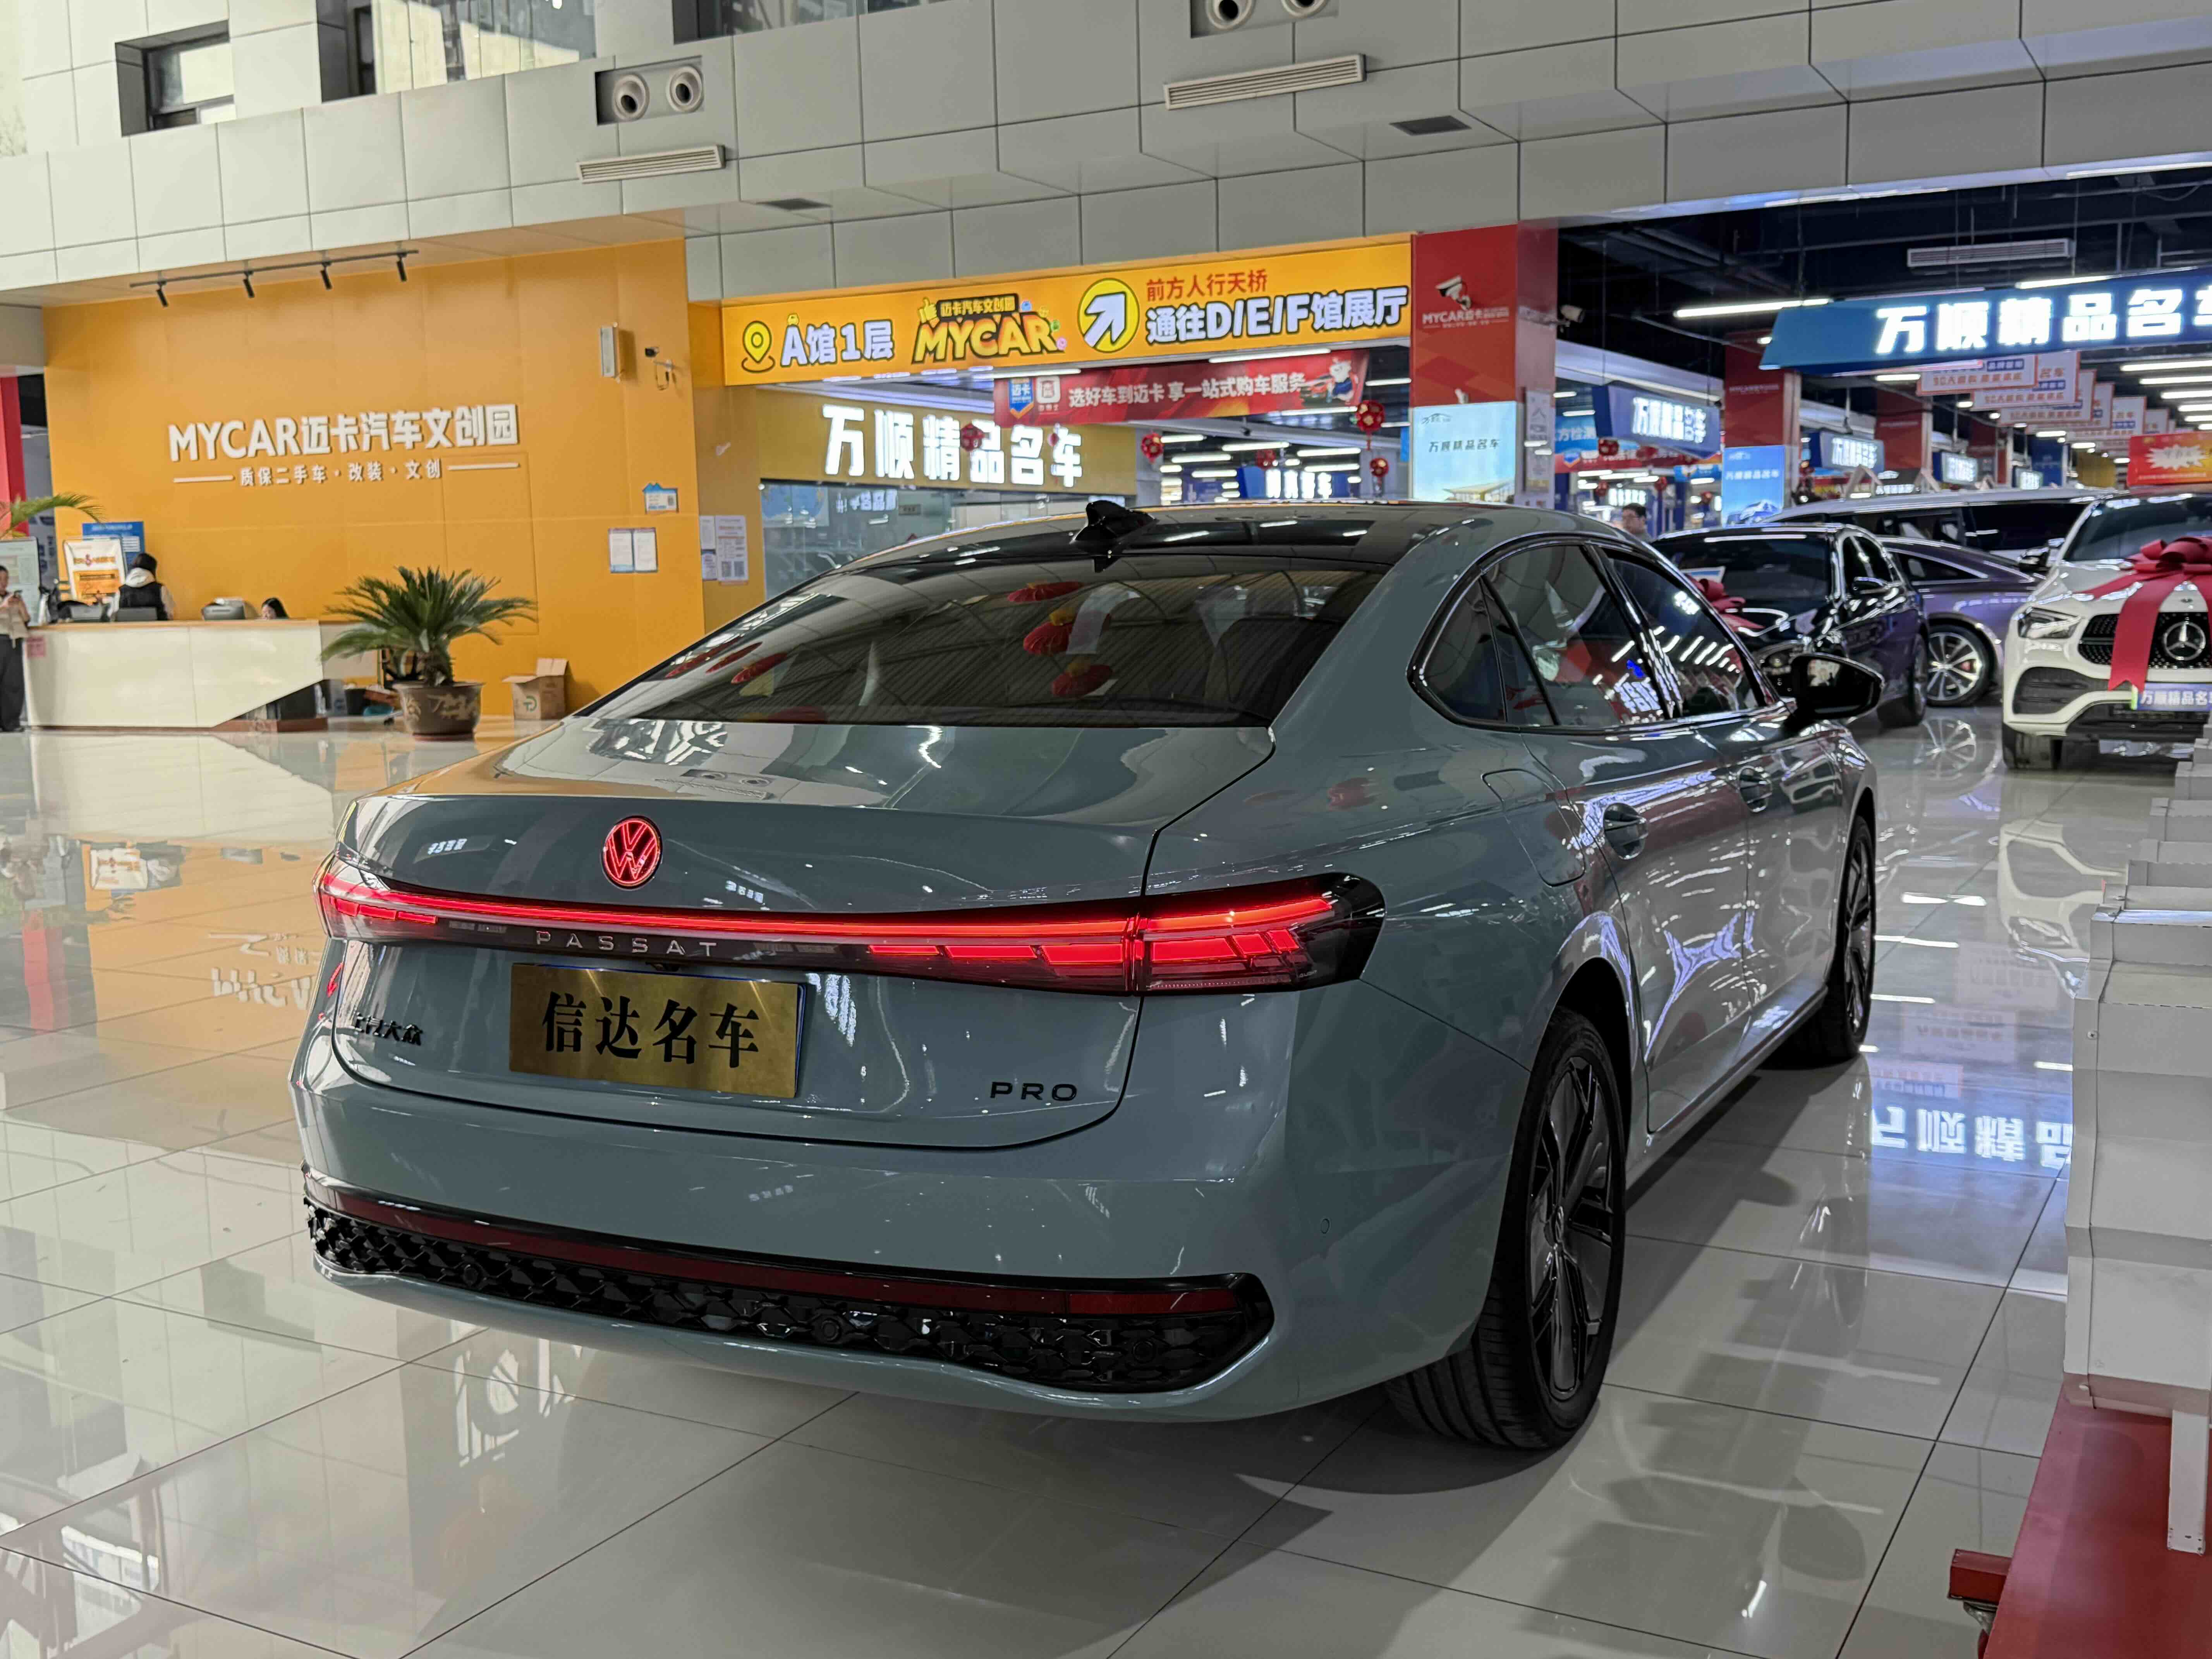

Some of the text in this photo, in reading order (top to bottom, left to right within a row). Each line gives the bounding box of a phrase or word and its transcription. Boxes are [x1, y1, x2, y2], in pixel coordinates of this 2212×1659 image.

[1146, 269, 1267, 301] 前方人行天桥
[912, 314, 1061, 363] MYCAR
[1146, 286, 1408, 344] 通往D/E/F馆展厅
[780, 320, 894, 367] A馆1层
[1068, 384, 1164, 409] 选好车到迈卡
[168, 404, 520, 462] MYCAR迈卡汽车文创园
[823, 404, 1083, 488] 万顺精品名车
[536, 930, 717, 957] PASSAT
[542, 991, 760, 1068] 信达名车
[990, 1082, 1077, 1101] PRO
